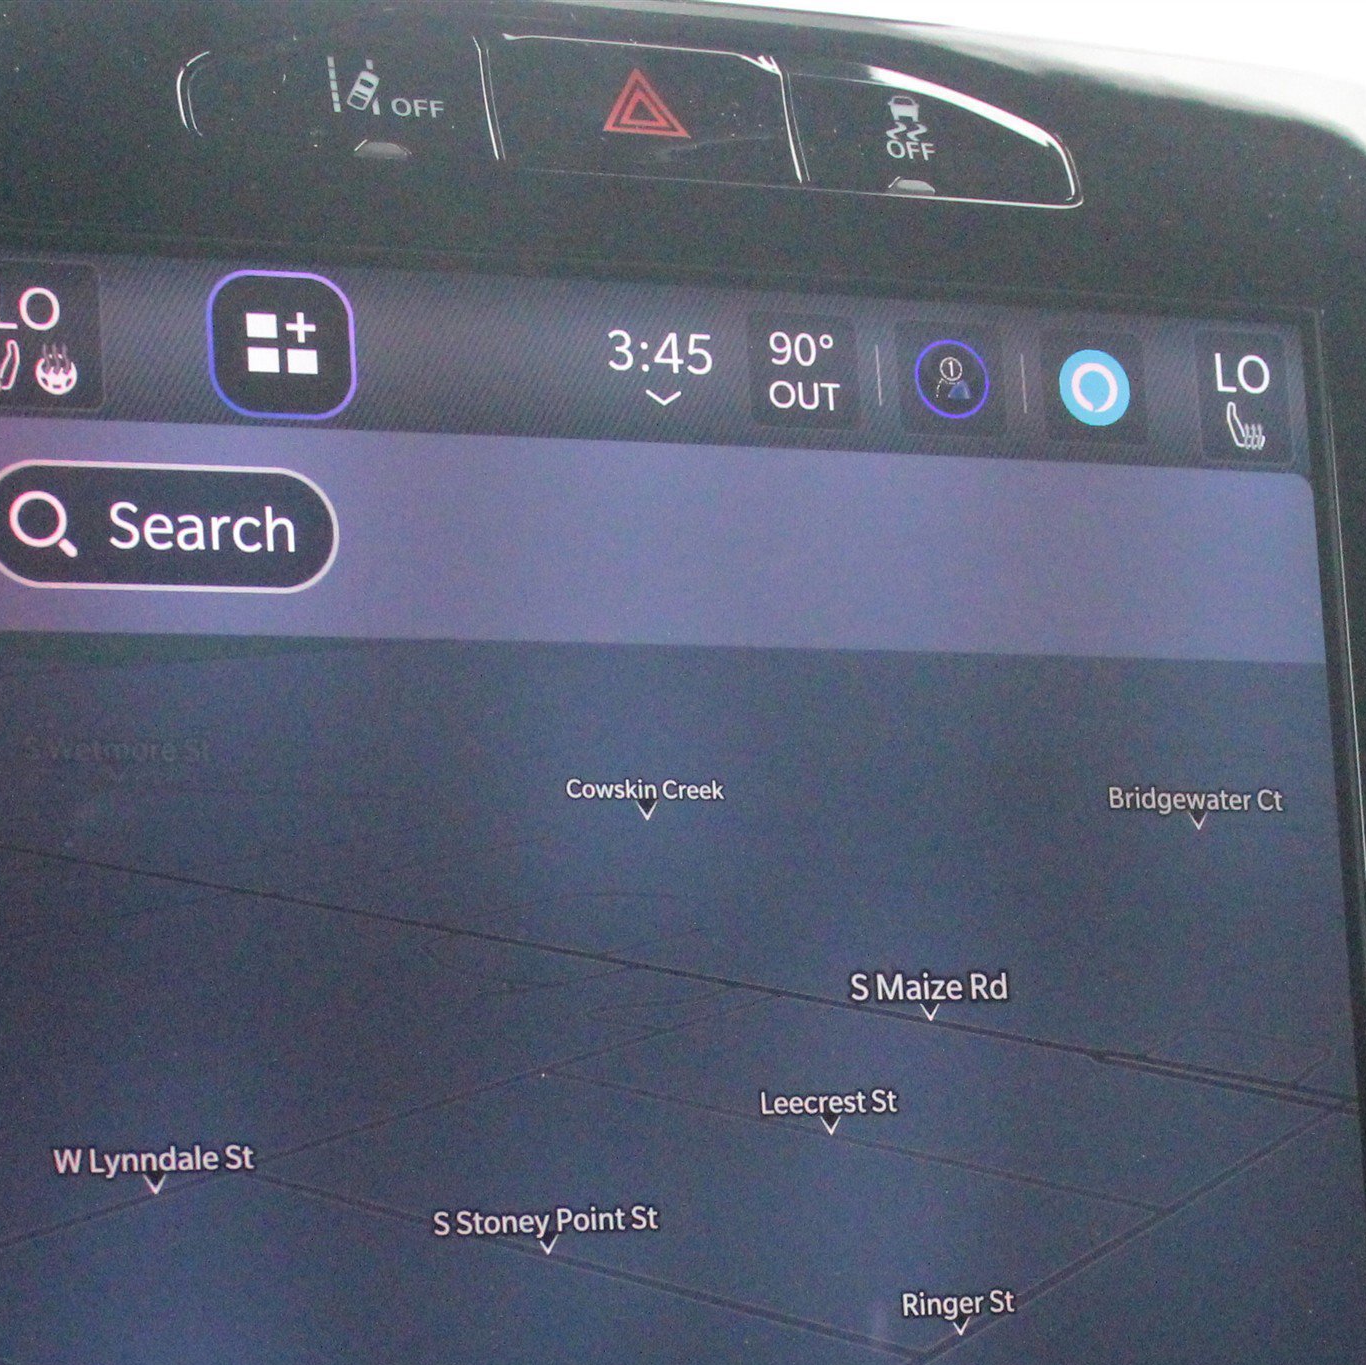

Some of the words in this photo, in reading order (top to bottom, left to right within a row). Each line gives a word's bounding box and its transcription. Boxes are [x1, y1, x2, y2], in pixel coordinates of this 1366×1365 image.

[391, 97, 444, 119] OFF
[886, 140, 935, 161] OFF
[607, 329, 713, 376] 3:45
[768, 331, 834, 368] 90°
[1215, 352, 1270, 395] LO
[769, 381, 840, 412] OUT
[109, 501, 297, 554] Search
[565, 778, 657, 801] Cowskin
[662, 779, 725, 801] Creek
[1108, 787, 1251, 814] Bridgewater
[1256, 789, 1283, 812] Ct
[850, 974, 869, 1002] S
[876, 973, 962, 1001] Maize
[970, 972, 1008, 1001] Rd
[760, 1092, 866, 1115] Leecrest
[870, 1089, 897, 1113] St
[53, 1148, 83, 1175] W
[88, 1145, 219, 1179] Lynndale
[225, 1144, 255, 1170] St
[433, 1211, 450, 1235] S
[456, 1210, 550, 1239] Stoney
[556, 1207, 625, 1232] Point
[630, 1206, 658, 1230] St
[902, 1293, 983, 1321] Ringer
[989, 1290, 1015, 1313] St
